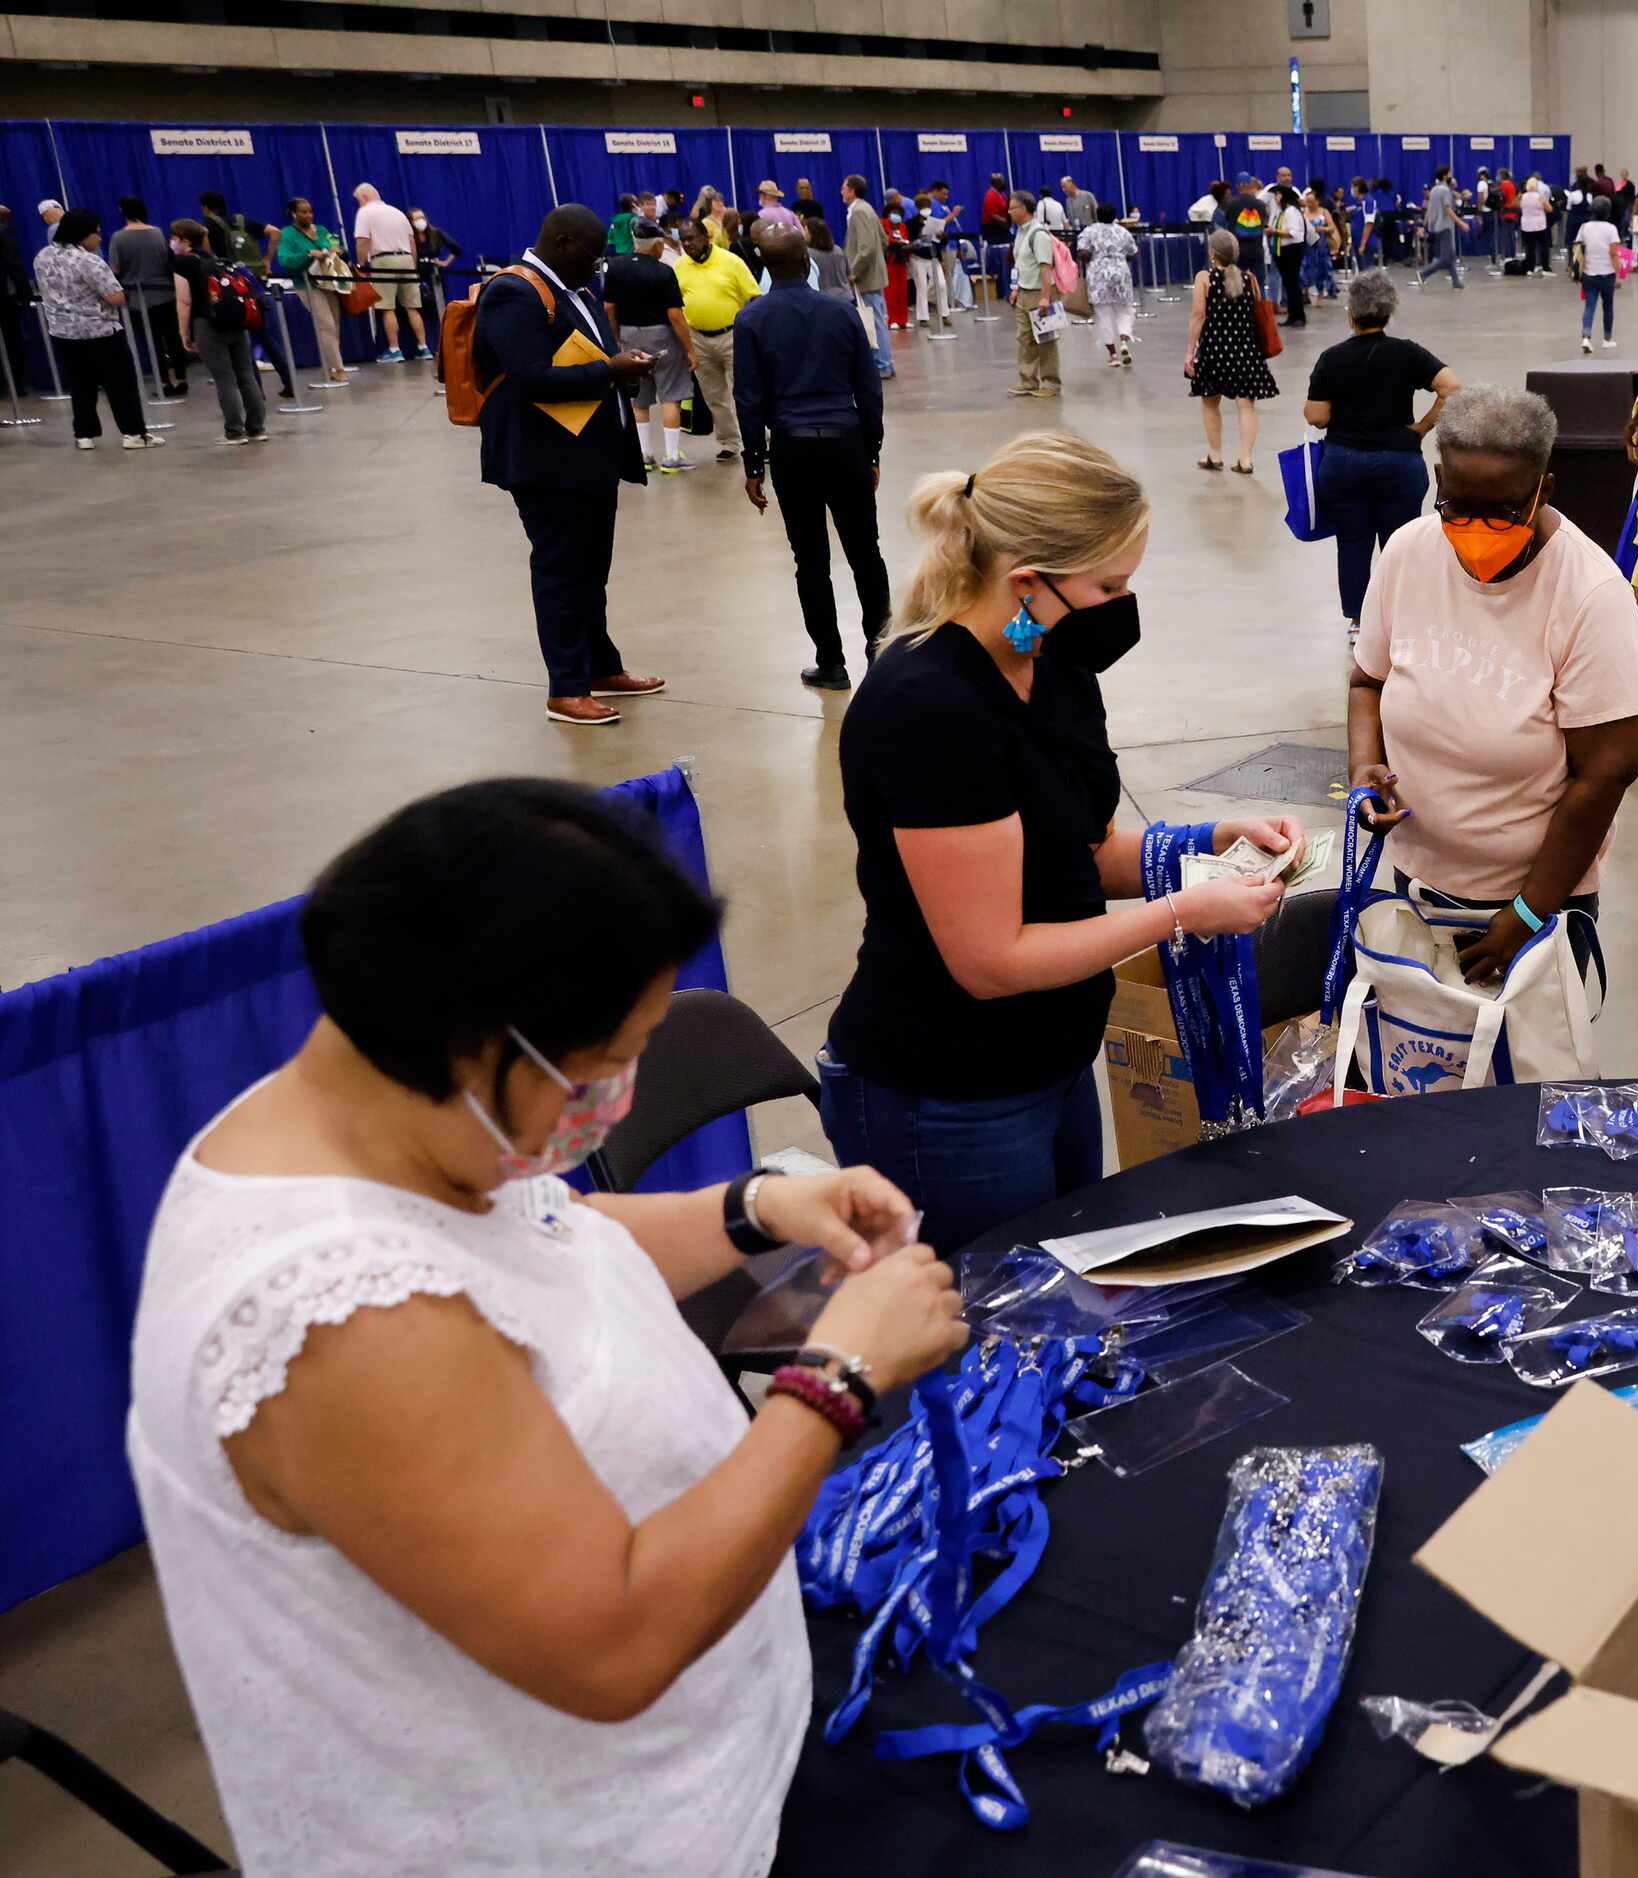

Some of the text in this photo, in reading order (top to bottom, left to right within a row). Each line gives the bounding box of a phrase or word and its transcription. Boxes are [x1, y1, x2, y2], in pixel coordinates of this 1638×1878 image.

[160, 138, 194, 147] Senate
[195, 137, 233, 147] District
[1144, 833, 1154, 868] WOMEN
[1157, 833, 1174, 863] TEXAS
[1346, 815, 1357, 861] DEMOCRATIC
[1344, 861, 1354, 893] WOMEN
[1228, 977, 1241, 1002] TEXAS
[1388, 1042, 1408, 1072] EAST
[1408, 1040, 1454, 1061] TEXAS
[1087, 1687, 1137, 1719] TEXAS
